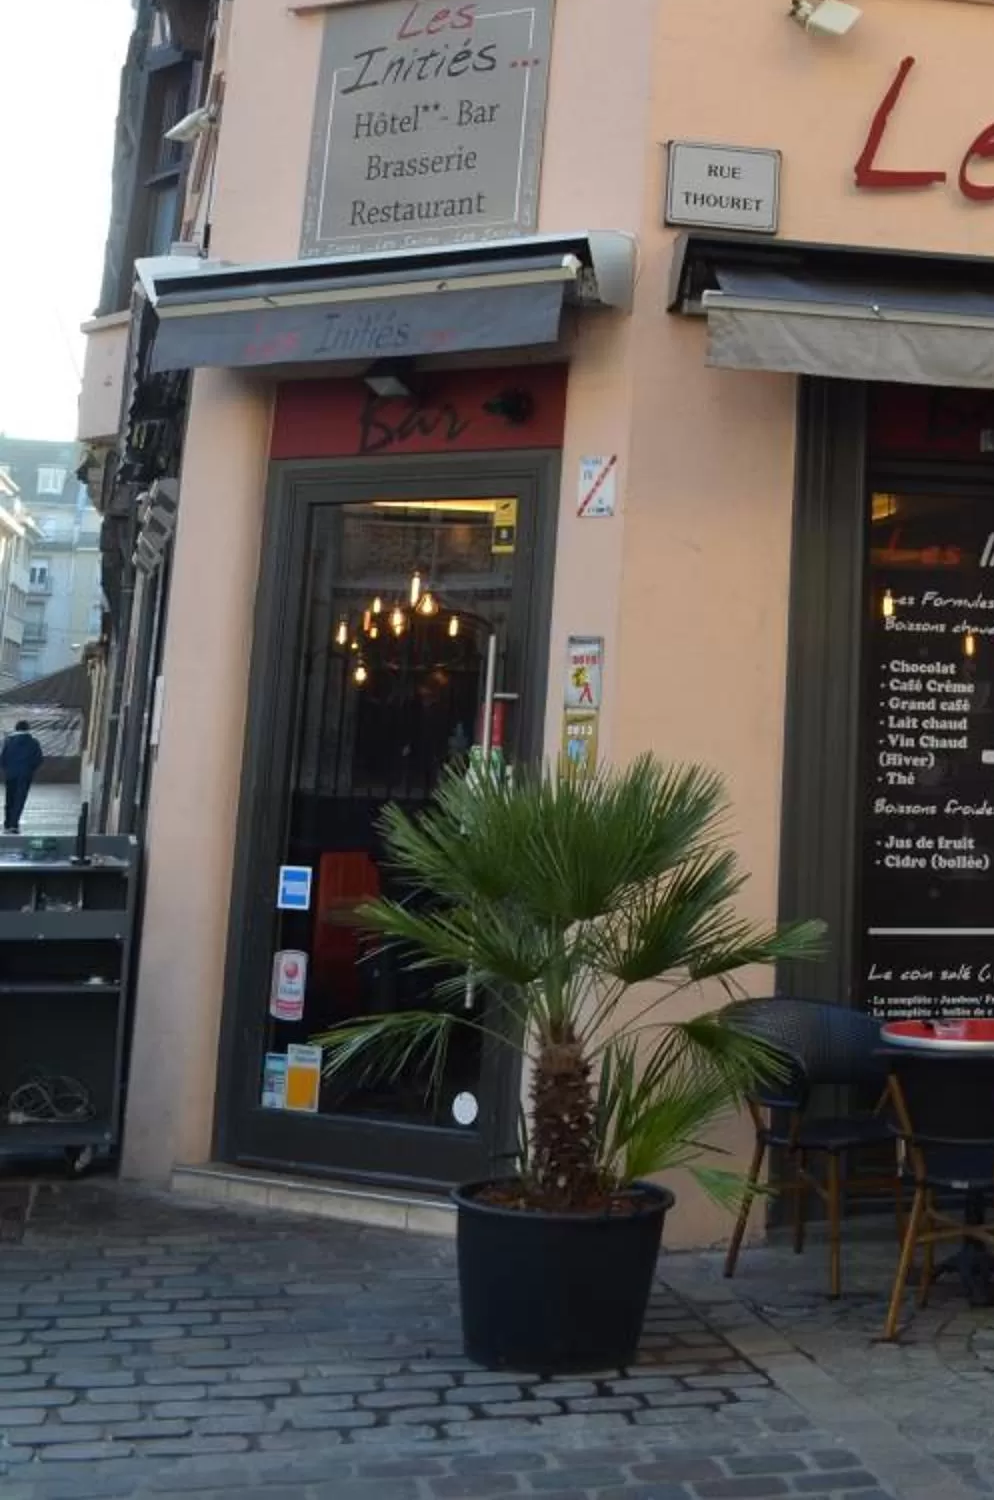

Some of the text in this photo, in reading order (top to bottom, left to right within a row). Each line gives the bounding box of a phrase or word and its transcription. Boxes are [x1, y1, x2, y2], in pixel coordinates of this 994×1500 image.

[397, 2, 478, 41] Les
[341, 38, 497, 95] Initiés
[457, 99, 500, 127] Bar
[365, 146, 478, 181] Brasserie
[707, 164, 742, 179] RUE
[350, 192, 487, 226] Restaurant
[681, 191, 764, 212] THOURET
[358, 397, 472, 454] Bar
[880, 528, 961, 565] Les
[884, 615, 946, 633] Boissons
[889, 660, 957, 674] Chocolat
[889, 679, 922, 692] Café
[888, 697, 971, 712] Grand café
[888, 715, 968, 730] Lait chaud
[887, 733, 968, 749] Vin Chaud
[879, 750, 935, 769] (Hiver)
[886, 772, 915, 785] Thé
[874, 797, 937, 815] Boissons
[884, 835, 975, 849] Jus de fruit
[884, 855, 927, 868] Cidre
[868, 963, 892, 980] Le
[900, 968, 933, 980] coin
